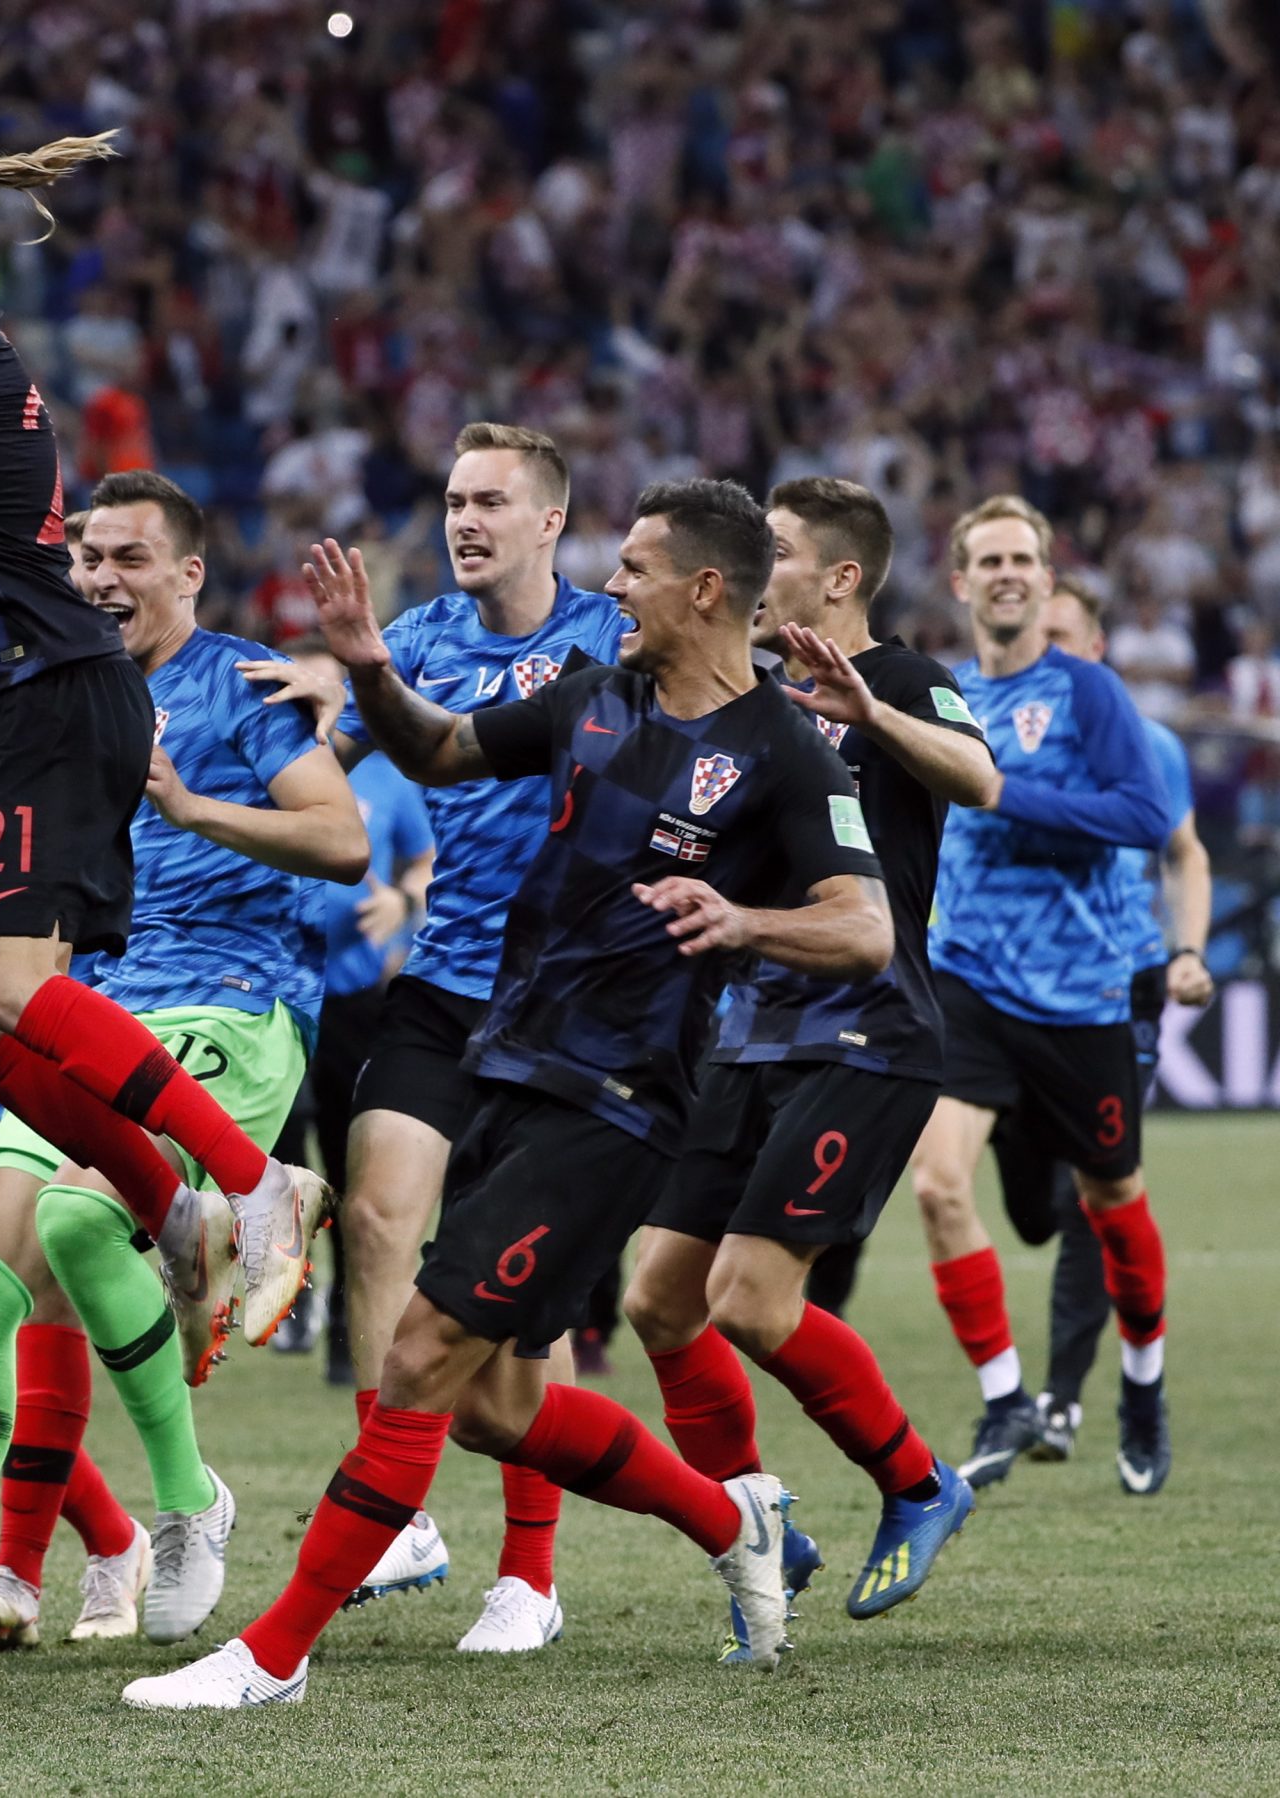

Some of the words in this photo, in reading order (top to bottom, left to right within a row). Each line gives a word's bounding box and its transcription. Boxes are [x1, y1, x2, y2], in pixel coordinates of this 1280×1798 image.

[474, 666, 506, 698] 14
[174, 1032, 228, 1082] 12
[1097, 1094, 1126, 1147] 3
[805, 1130, 848, 1195] 9
[496, 1224, 551, 1287] 6
